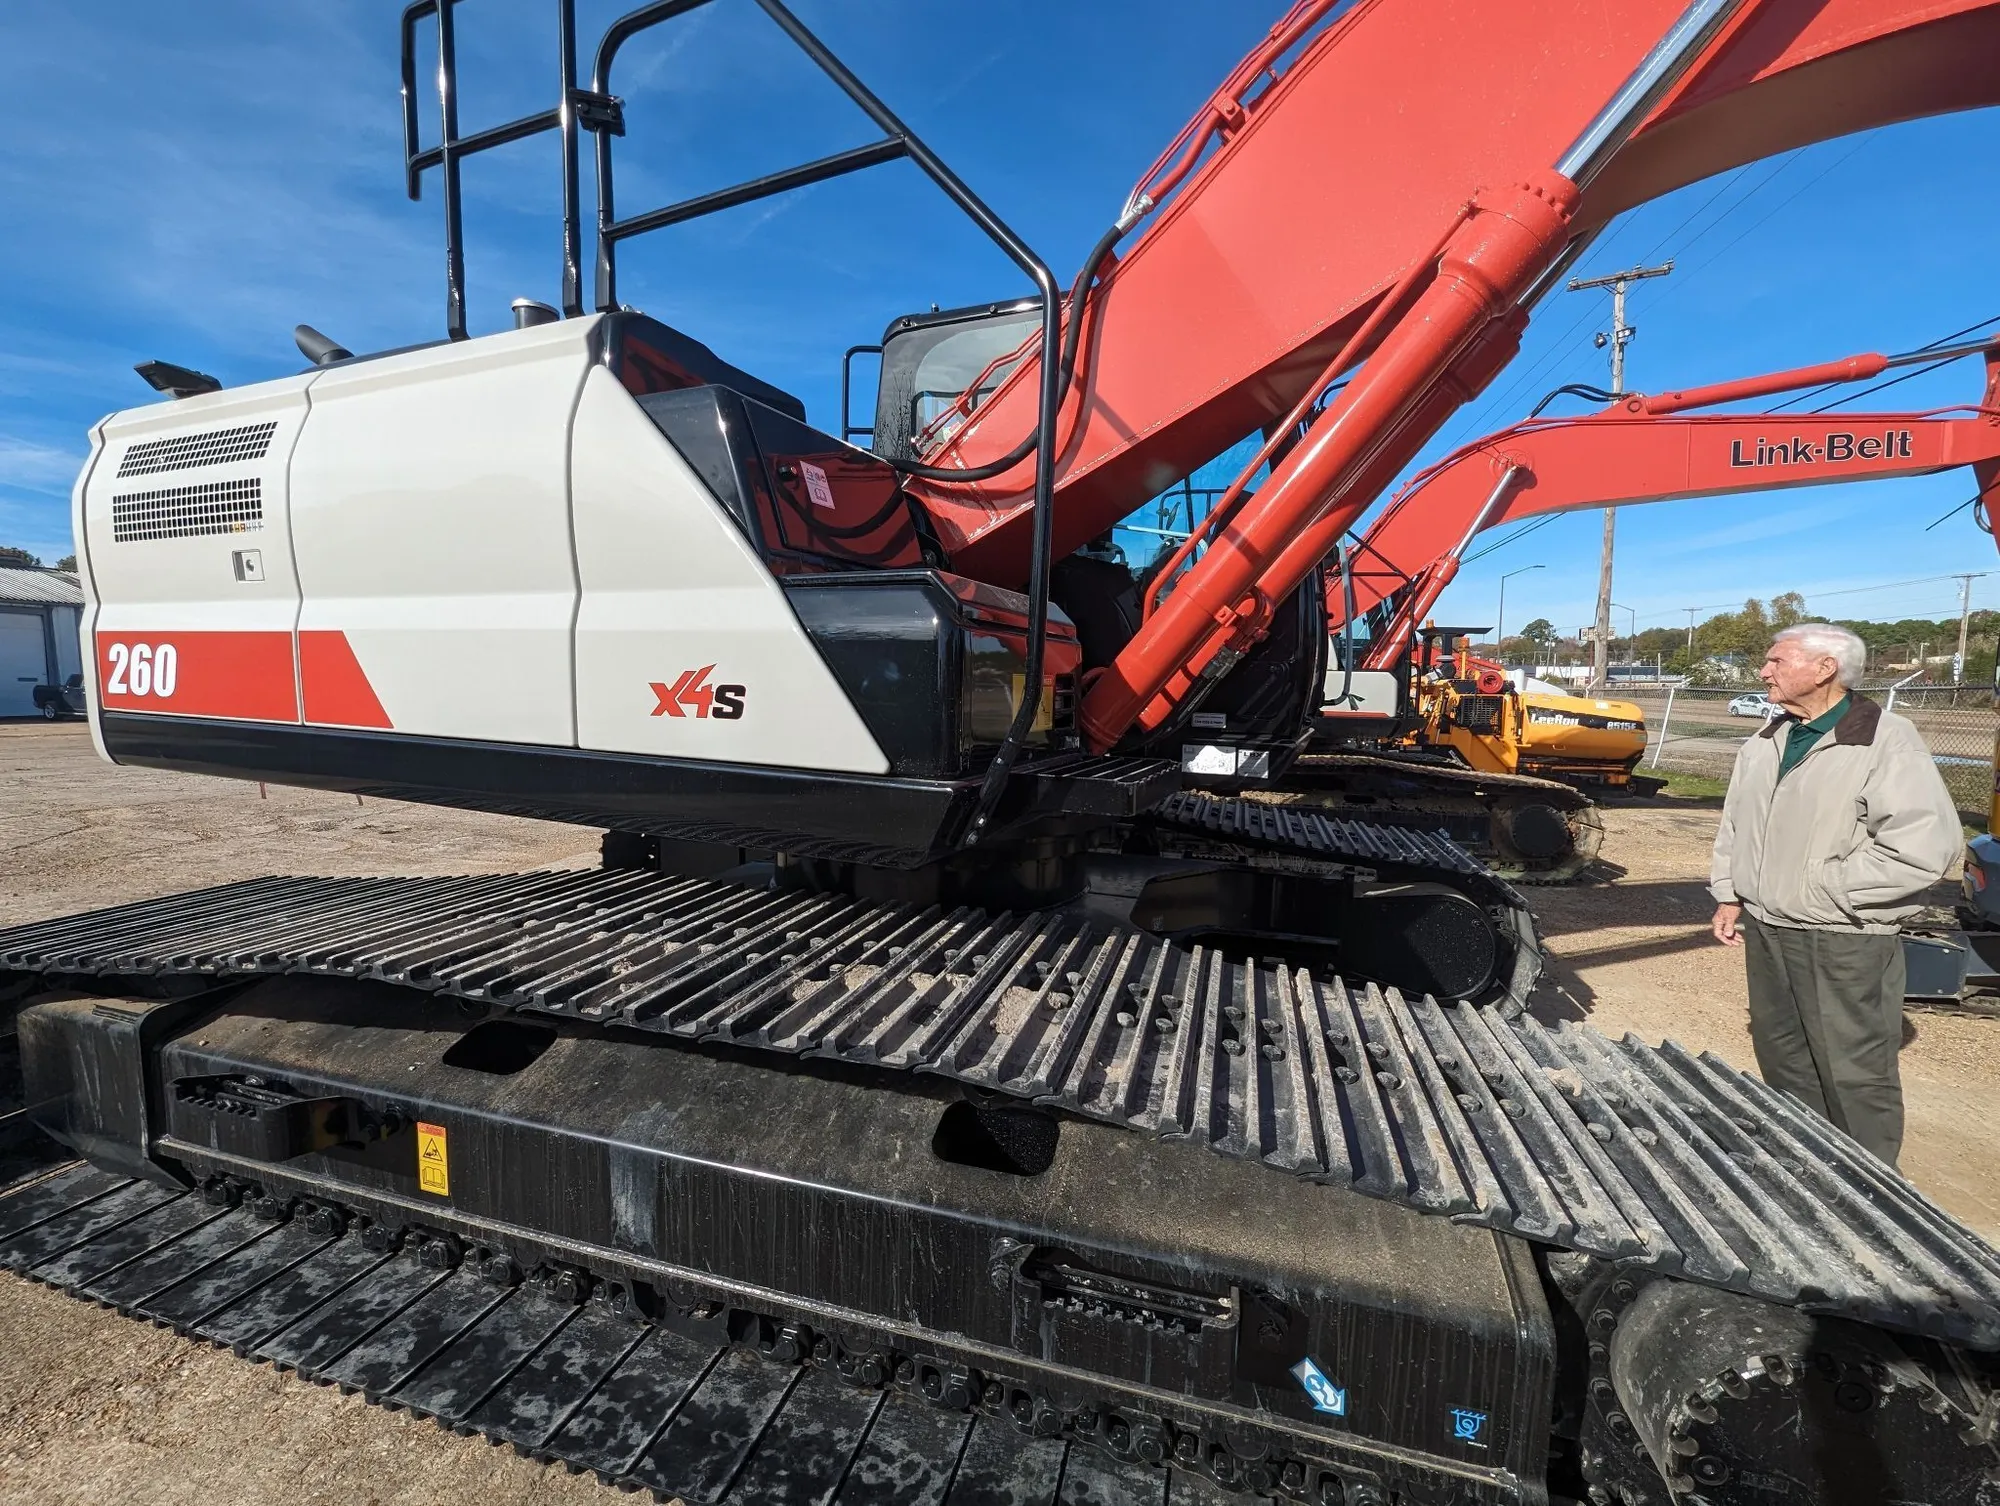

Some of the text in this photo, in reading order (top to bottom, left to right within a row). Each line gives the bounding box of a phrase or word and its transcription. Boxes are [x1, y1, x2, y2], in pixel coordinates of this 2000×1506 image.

[1731, 430, 1913, 468] Link-Belt
[107, 642, 178, 698] 260
[647, 662, 747, 720] X4S
